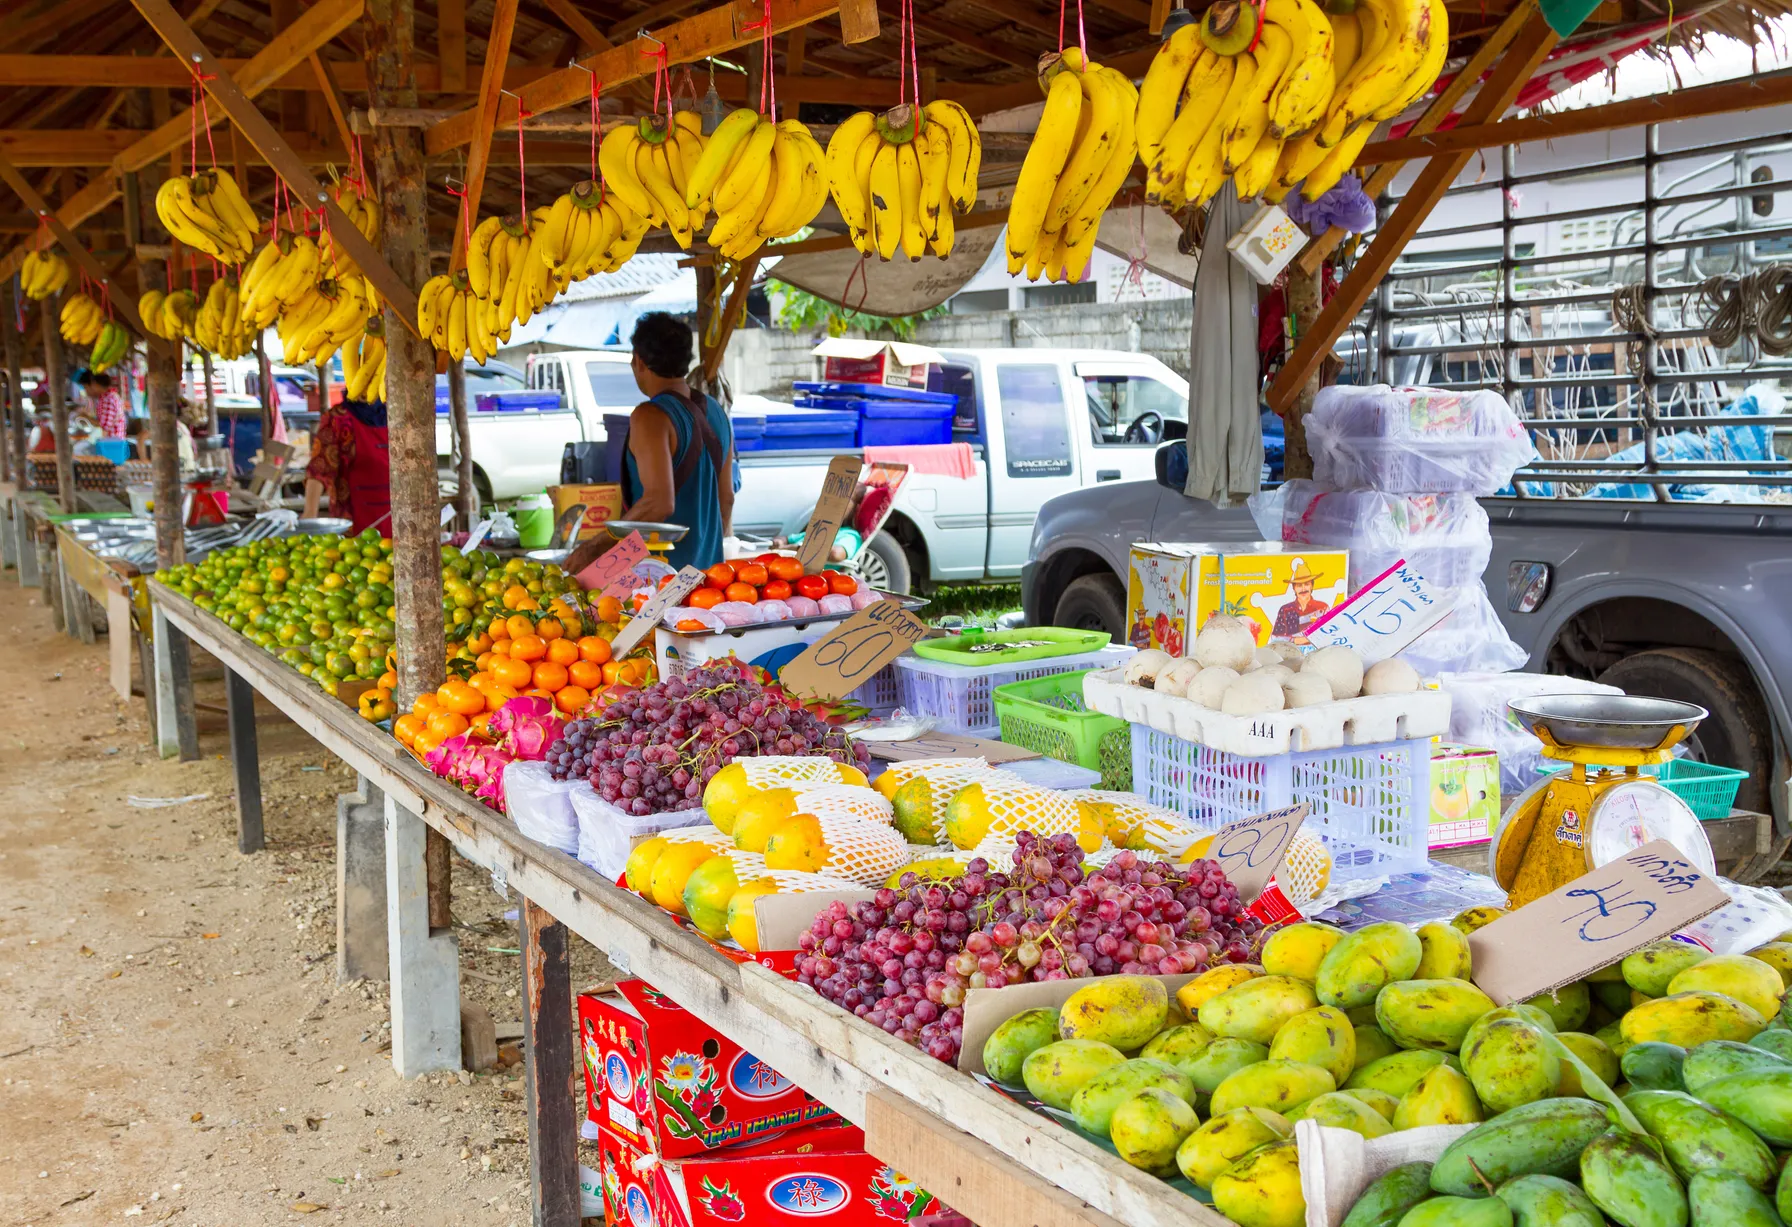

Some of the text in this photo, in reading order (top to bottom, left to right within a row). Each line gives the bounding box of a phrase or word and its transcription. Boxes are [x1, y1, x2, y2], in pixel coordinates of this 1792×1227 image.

[799, 518, 832, 567] 15
[1343, 584, 1417, 636] 15
[813, 622, 894, 679] 60
[1248, 721, 1275, 740] AAA
[745, 1107, 802, 1136] THANH
[788, 1178, 830, 1208] 祿
